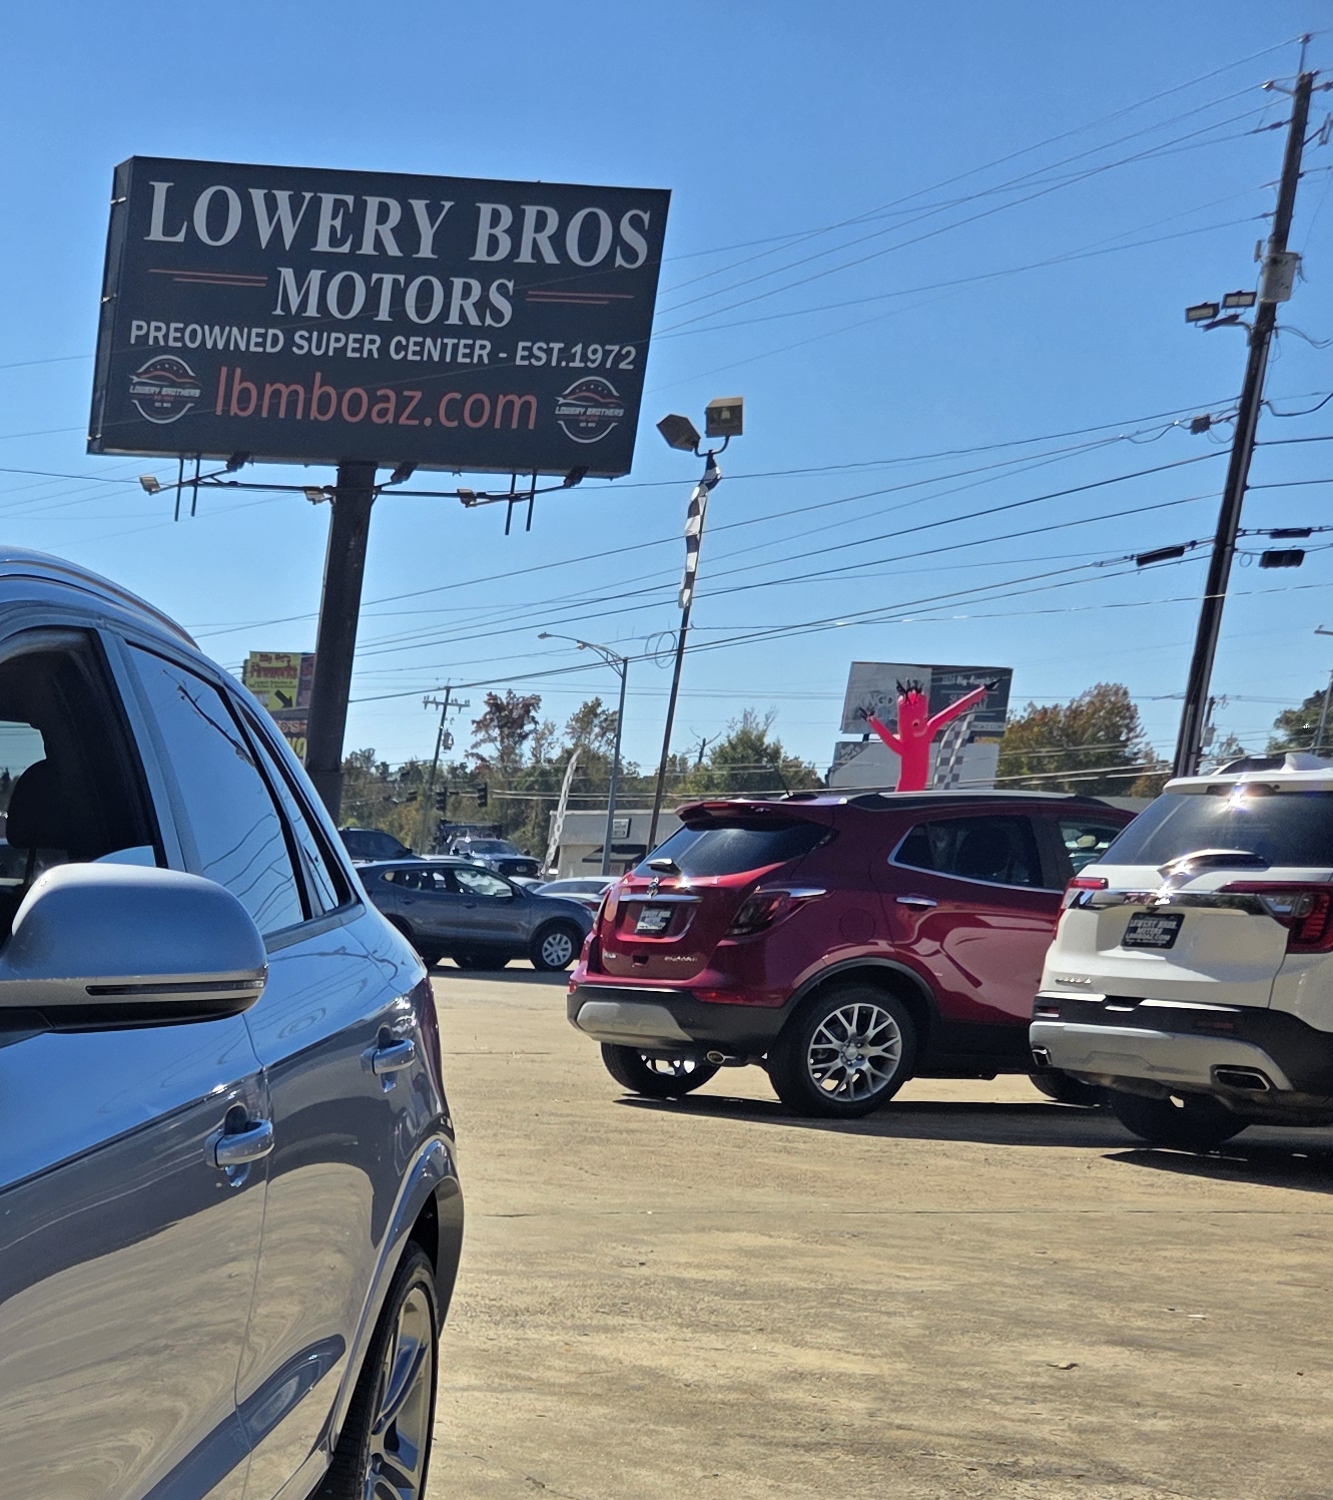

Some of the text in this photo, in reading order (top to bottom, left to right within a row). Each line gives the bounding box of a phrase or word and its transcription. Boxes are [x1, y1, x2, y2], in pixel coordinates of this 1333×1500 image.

[143, 180, 652, 271] LOWERY BROS
[272, 266, 516, 328] MOTORS
[129, 319, 285, 354] PREOWNED
[291, 330, 380, 360] SUPER
[389, 335, 491, 365] CENTER
[515, 341, 637, 370] EST.1972
[215, 366, 538, 430] lbmboaz.com
